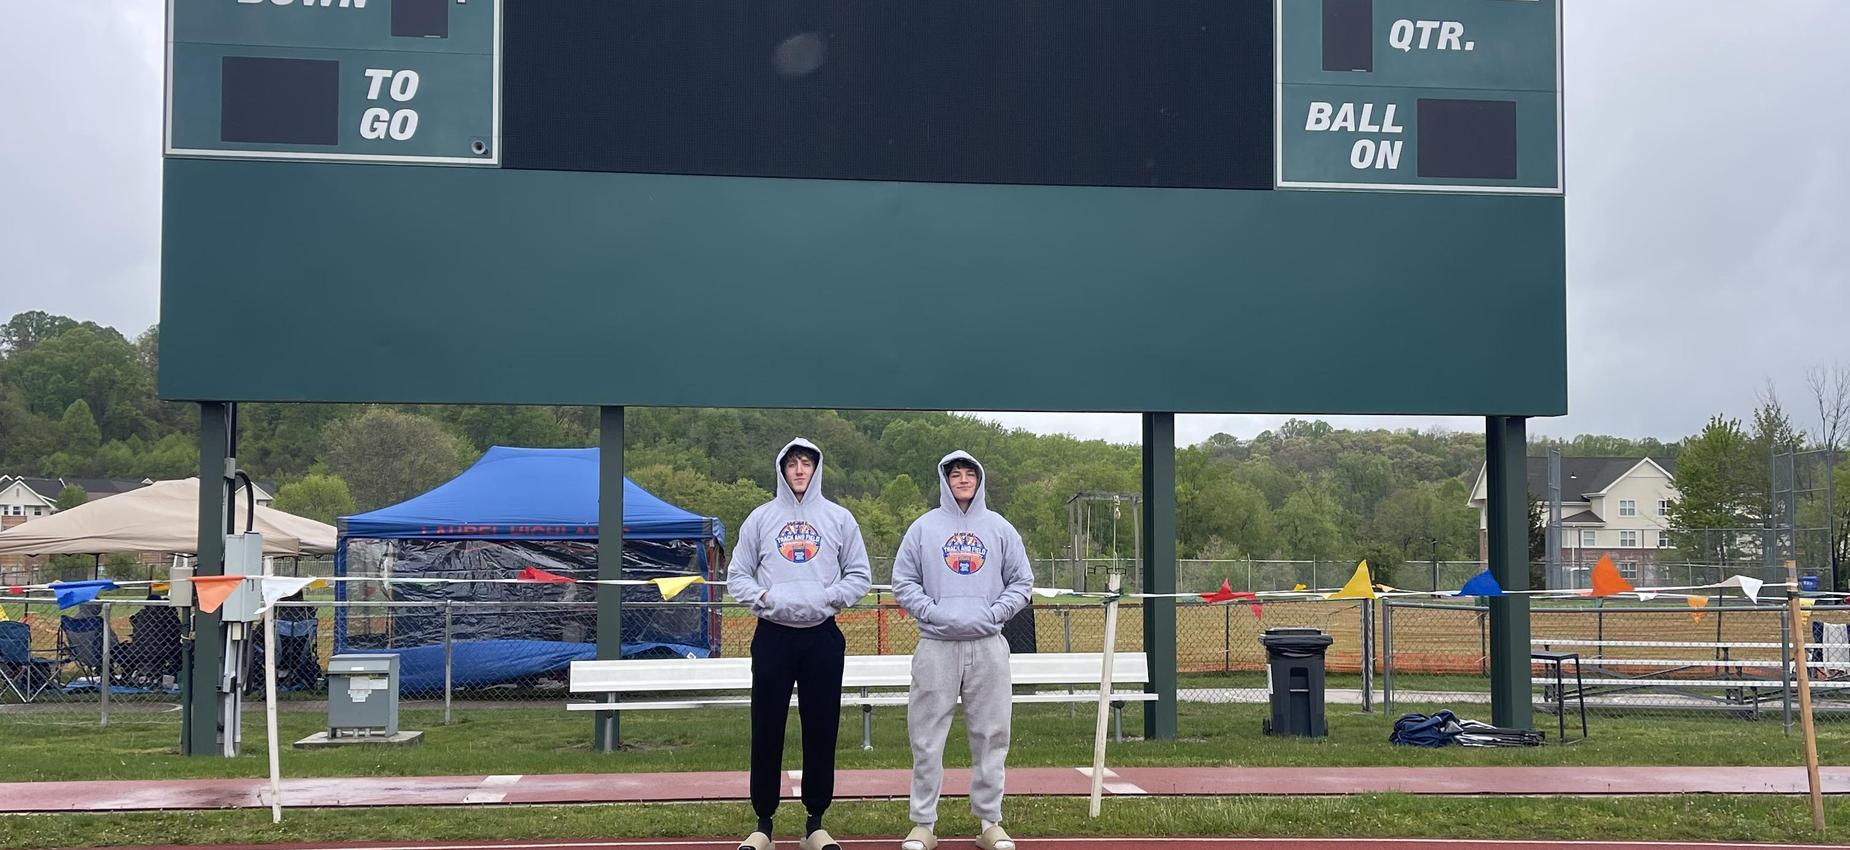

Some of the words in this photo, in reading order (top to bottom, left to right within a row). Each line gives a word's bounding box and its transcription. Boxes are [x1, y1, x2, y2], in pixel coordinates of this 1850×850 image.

[1389, 19, 1475, 52] QTR.
[364, 69, 419, 101] TO
[360, 107, 419, 140] GO
[1305, 101, 1404, 133] BALL
[1350, 139, 1403, 169] ON
